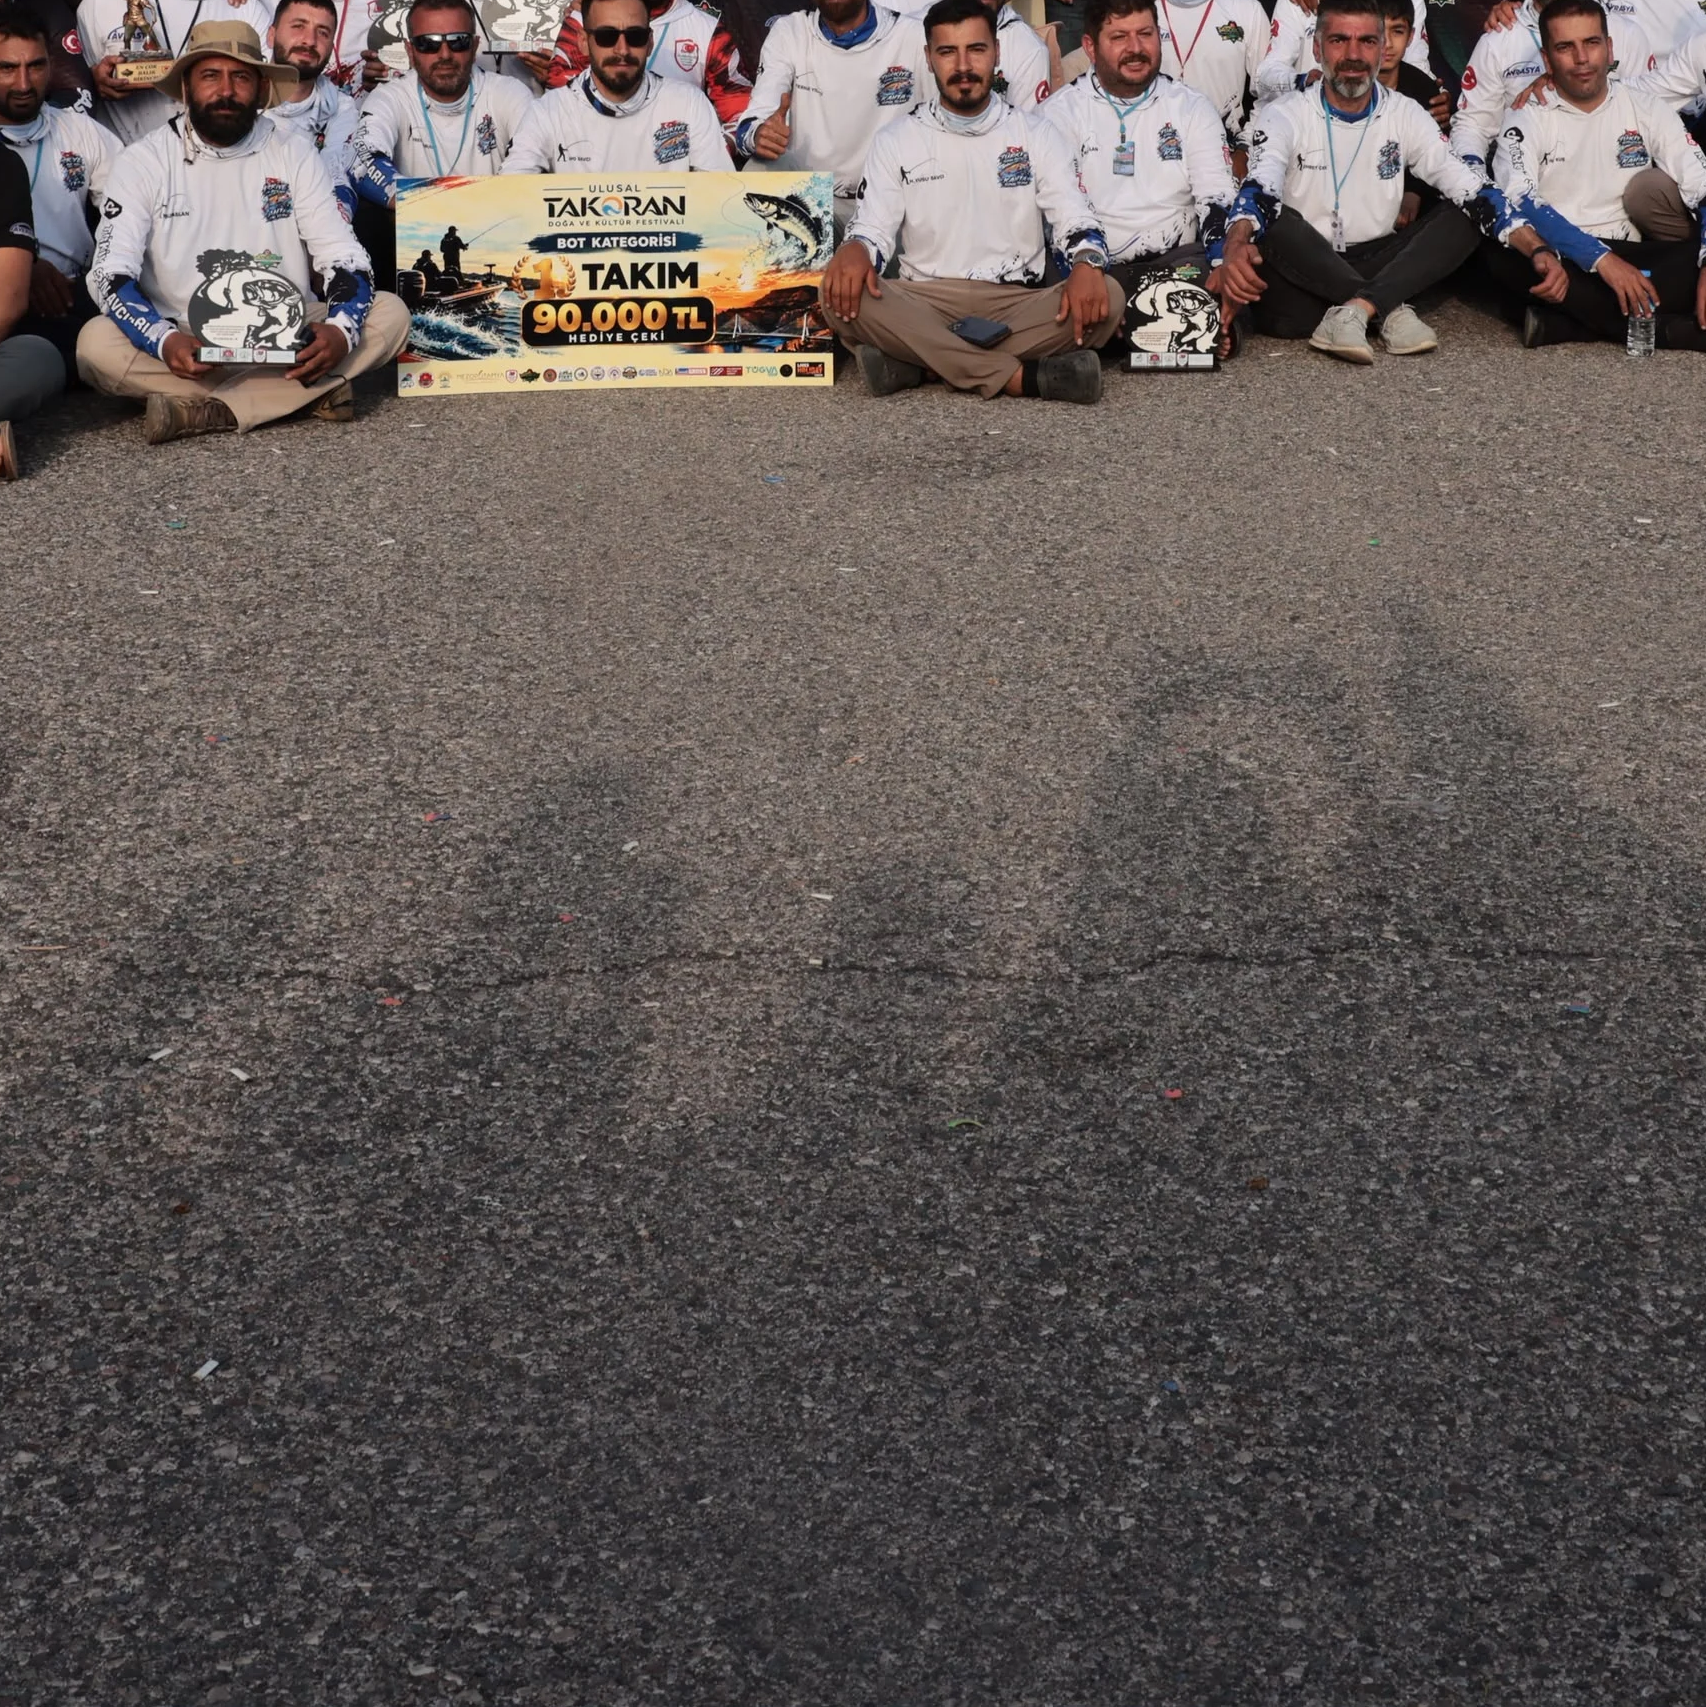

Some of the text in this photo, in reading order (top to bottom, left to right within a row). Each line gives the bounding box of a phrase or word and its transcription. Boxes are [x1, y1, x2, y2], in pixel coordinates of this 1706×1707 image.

[589, 184, 641, 193] ULUSAL
[543, 195, 686, 218] TAKORAN
[548, 219, 575, 227] DOĞA
[595, 218, 631, 227] KÜLTÜR
[636, 218, 685, 226] FESTİVALİ
[557, 233, 677, 249] BOT KATEGORİSİ
[582, 261, 699, 291] TAKIM
[532, 301, 707, 334] 90.000 TL
[569, 332, 665, 344] HEDİYE ÇEKİ
